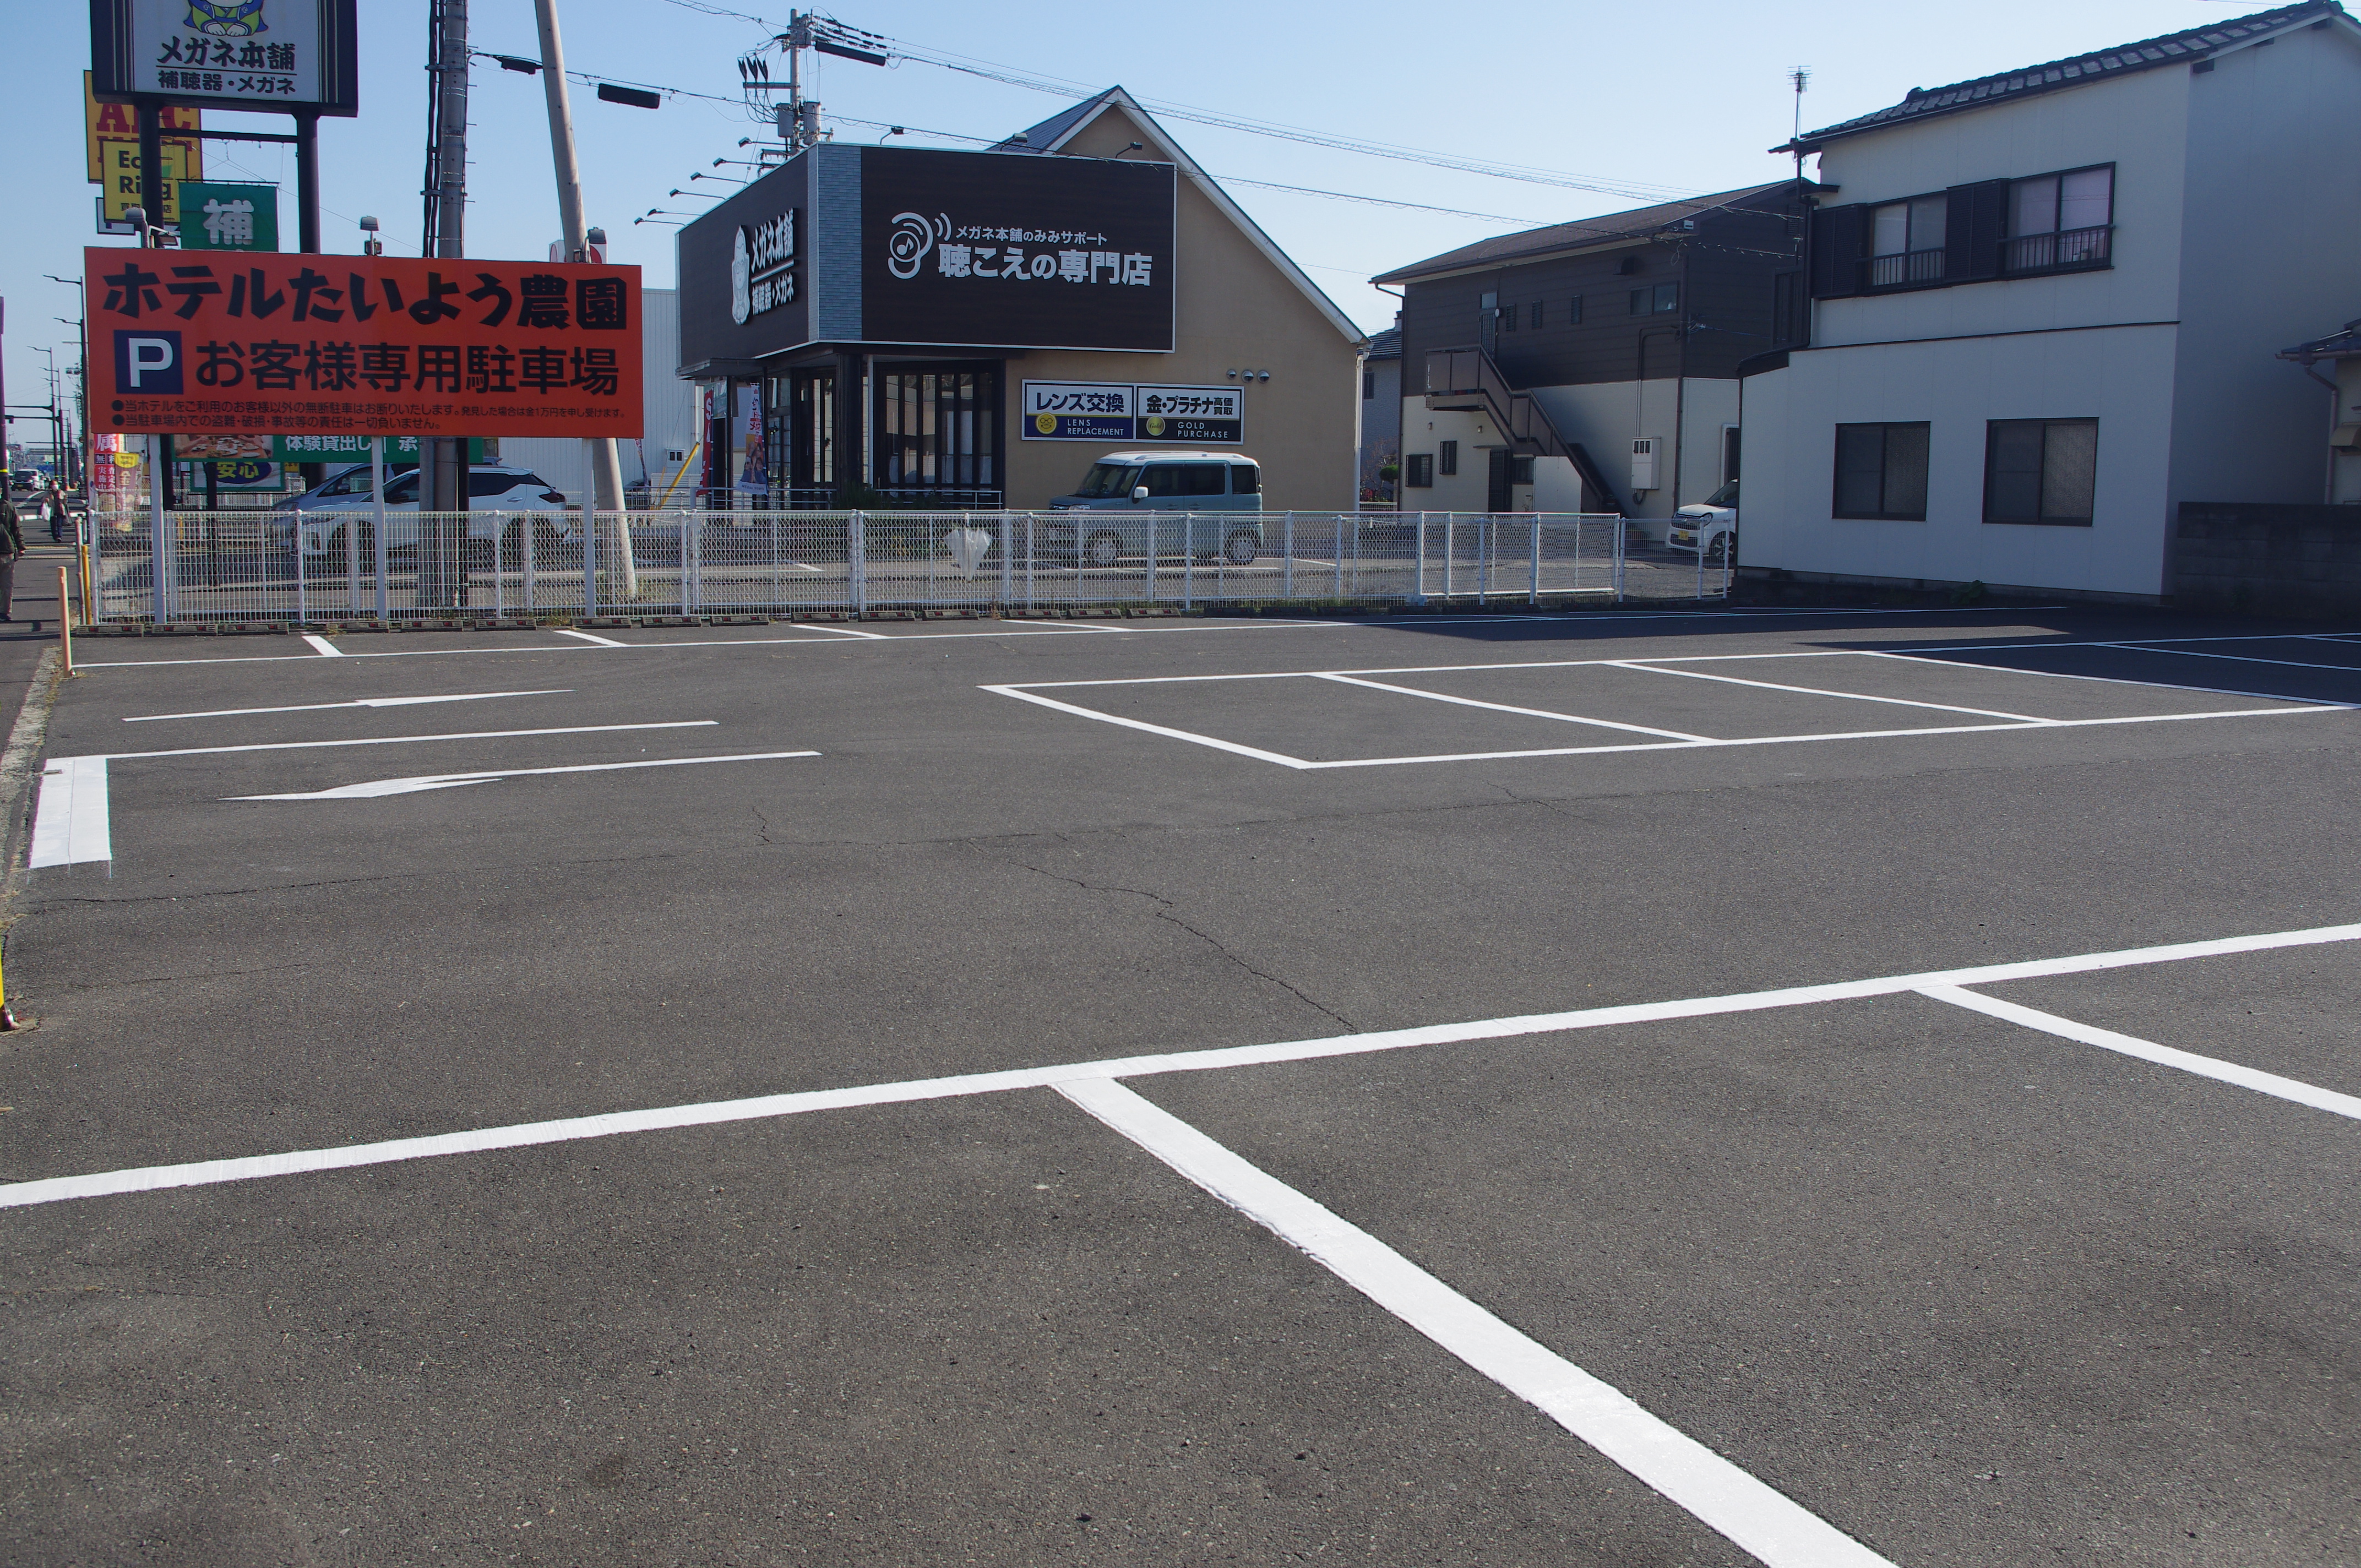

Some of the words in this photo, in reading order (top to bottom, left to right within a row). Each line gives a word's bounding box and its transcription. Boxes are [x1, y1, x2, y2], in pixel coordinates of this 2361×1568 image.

[157, 36, 296, 72] メガネ本舗
[158, 70, 296, 95] 補聴器・メガネ
[203, 199, 254, 244] 補
[956, 226, 1107, 246] メガネ本舗のみみサポート
[751, 207, 793, 274] メガネ本舗
[938, 243, 1152, 286] 聴こえの専門店
[103, 262, 627, 330] ホテルたいよう農園
[128, 337, 173, 388] P
[195, 340, 619, 395] お客様専用駐車場
[1037, 392, 1124, 413] レンズ交換
[1067, 418, 1091, 427] LENS
[1067, 427, 1124, 436] REPLACEMENT
